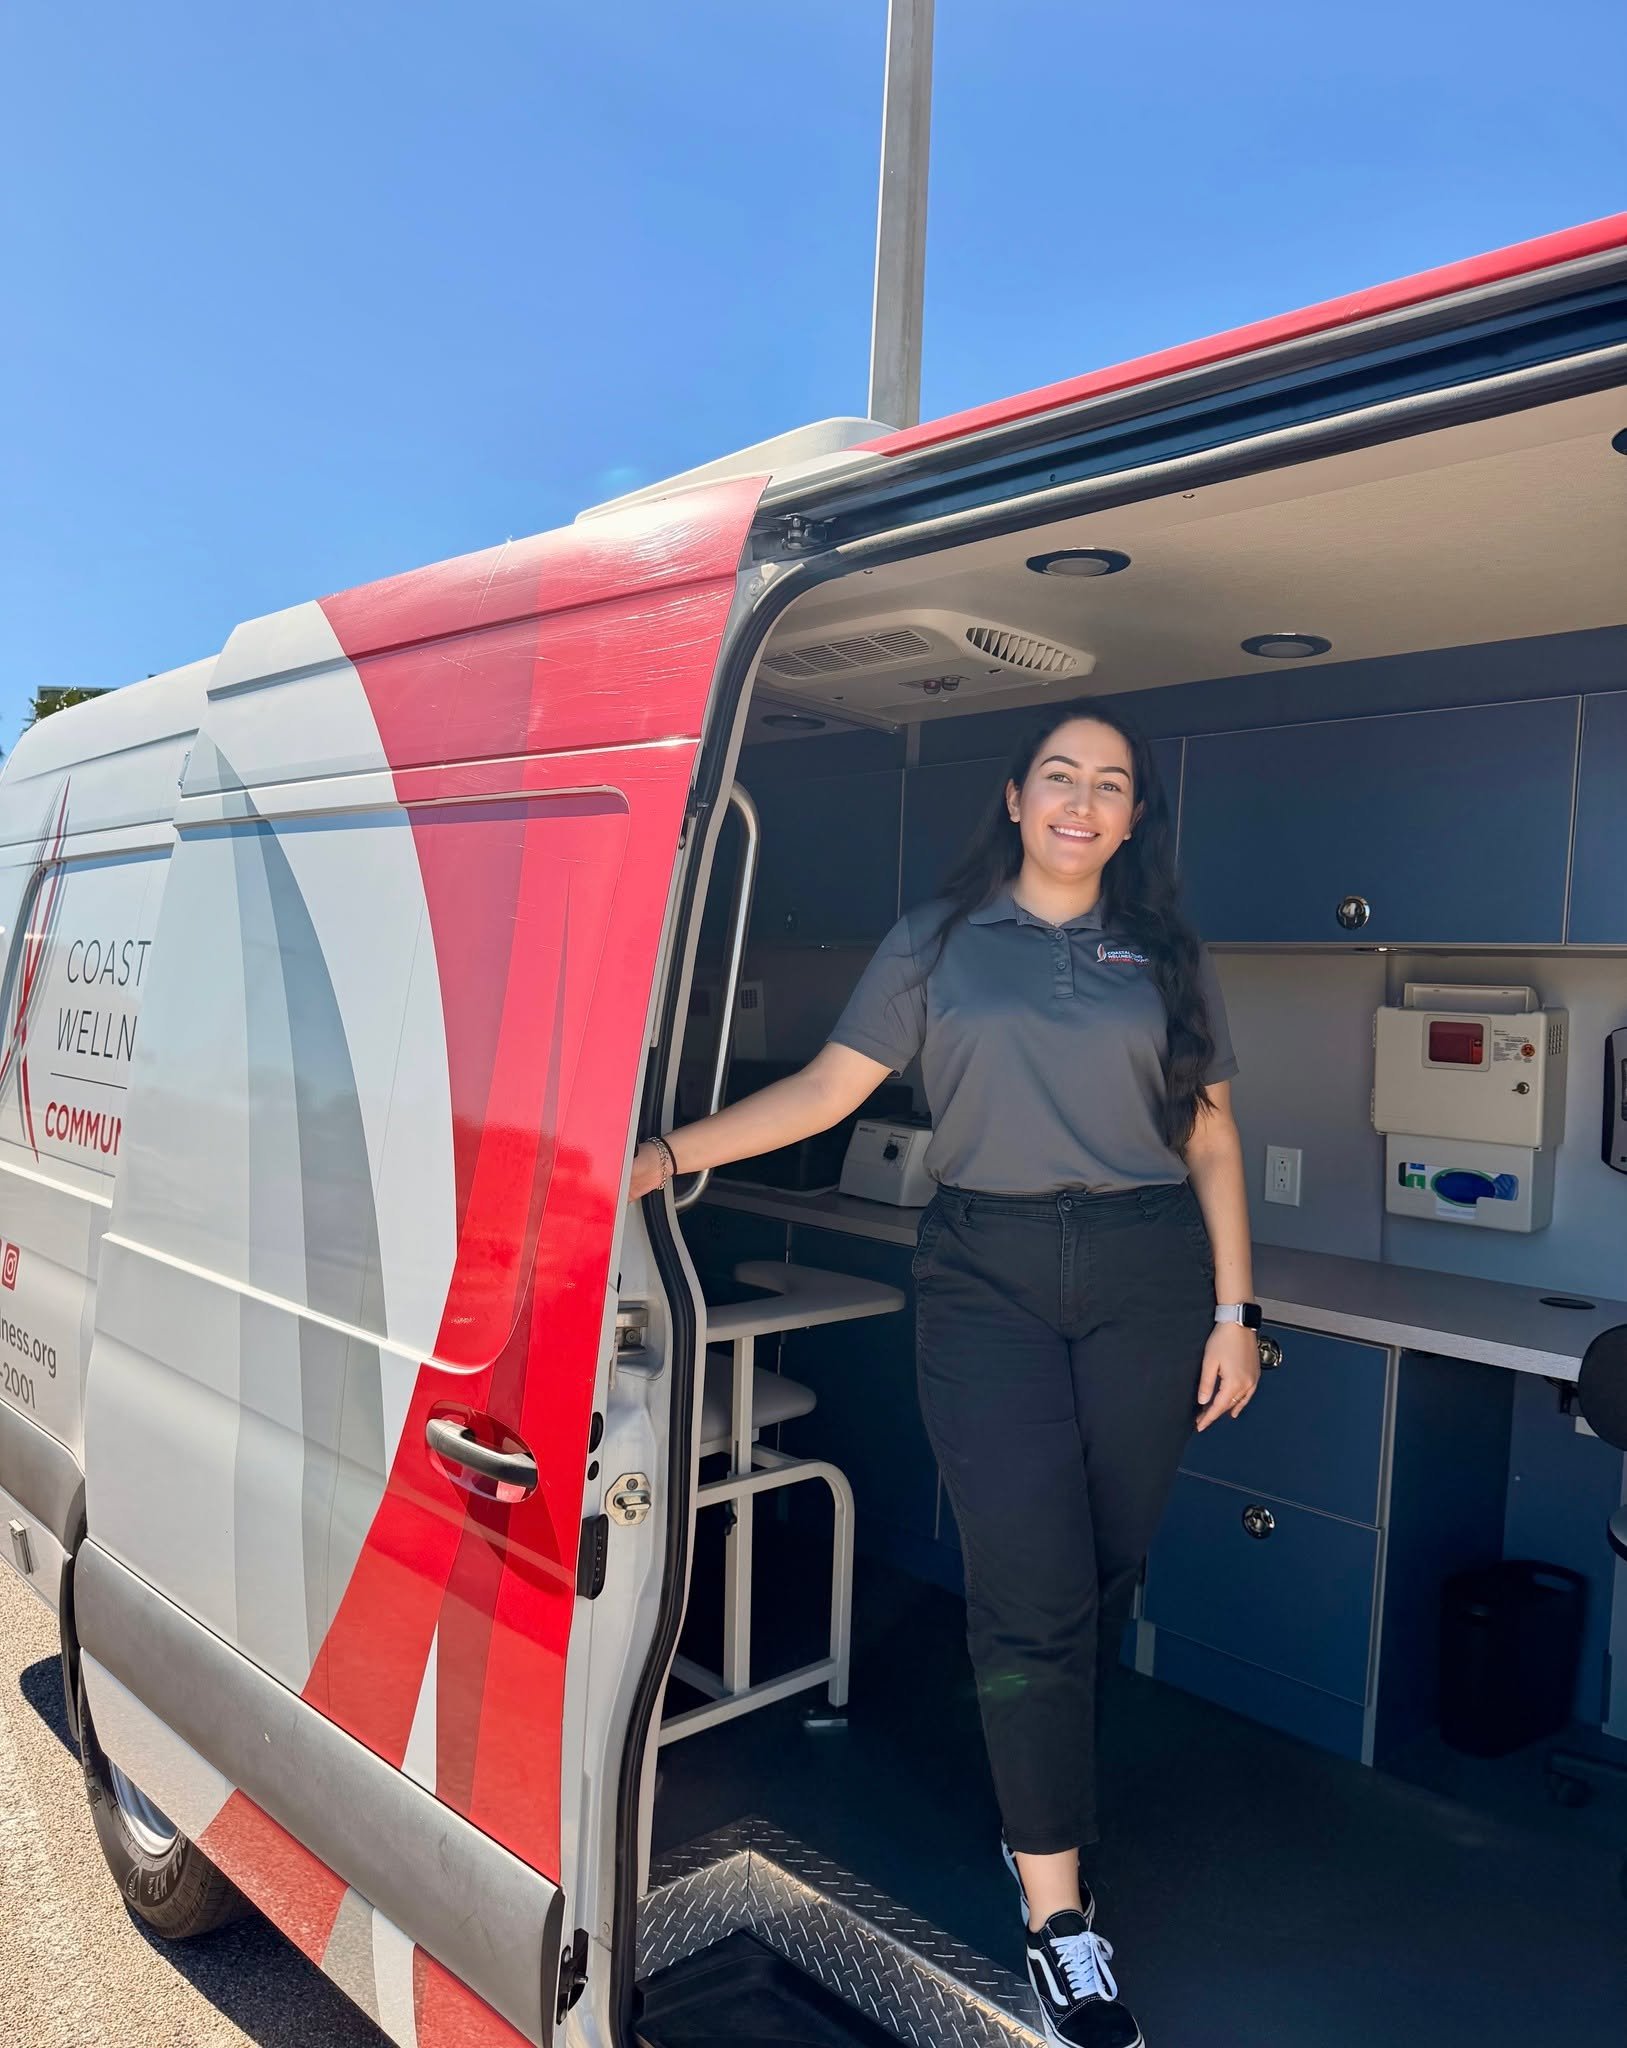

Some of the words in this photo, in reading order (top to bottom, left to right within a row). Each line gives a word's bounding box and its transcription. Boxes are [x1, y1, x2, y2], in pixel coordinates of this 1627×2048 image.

[67, 939, 151, 987] COAST
[57, 1007, 137, 1062] WELLN
[0, 1310, 57, 1379] ness.org
